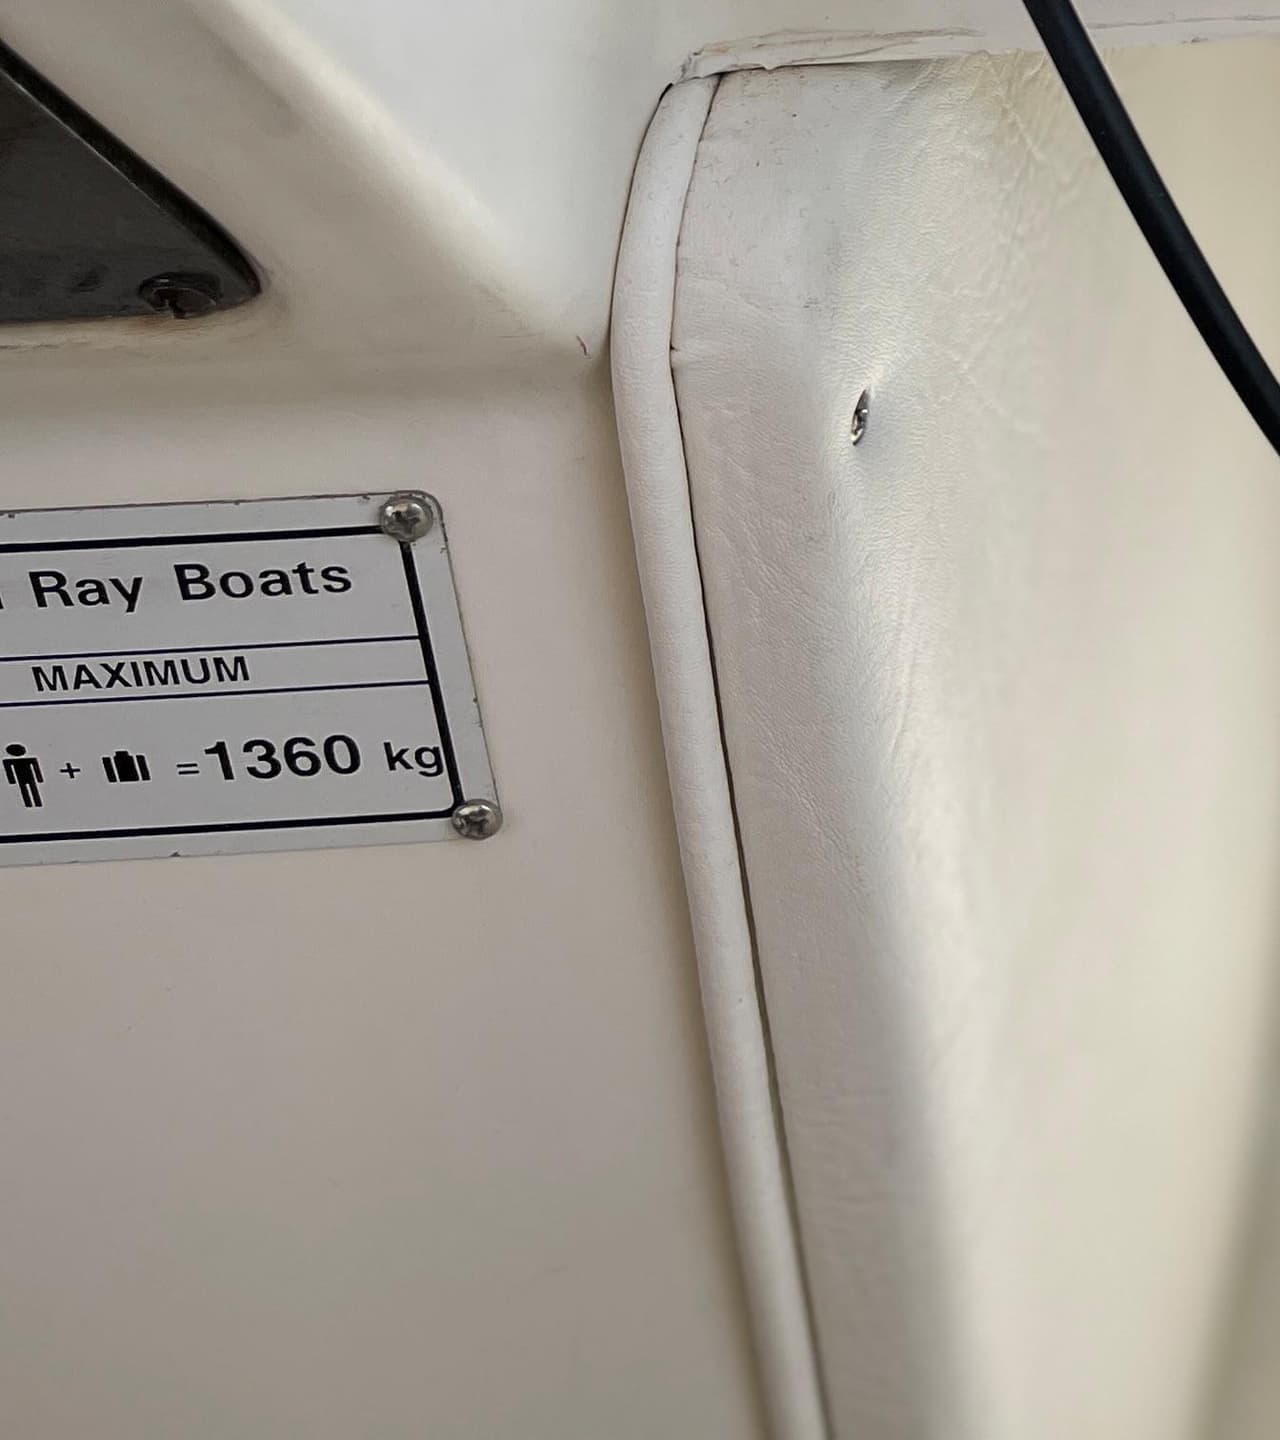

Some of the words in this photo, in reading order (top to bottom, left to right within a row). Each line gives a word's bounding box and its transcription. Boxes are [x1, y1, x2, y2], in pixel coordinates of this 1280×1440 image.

[28, 568, 144, 613] Ray
[173, 561, 353, 602] Boats
[31, 655, 251, 693] MAXIMUM
[383, 741, 445, 778] kg
